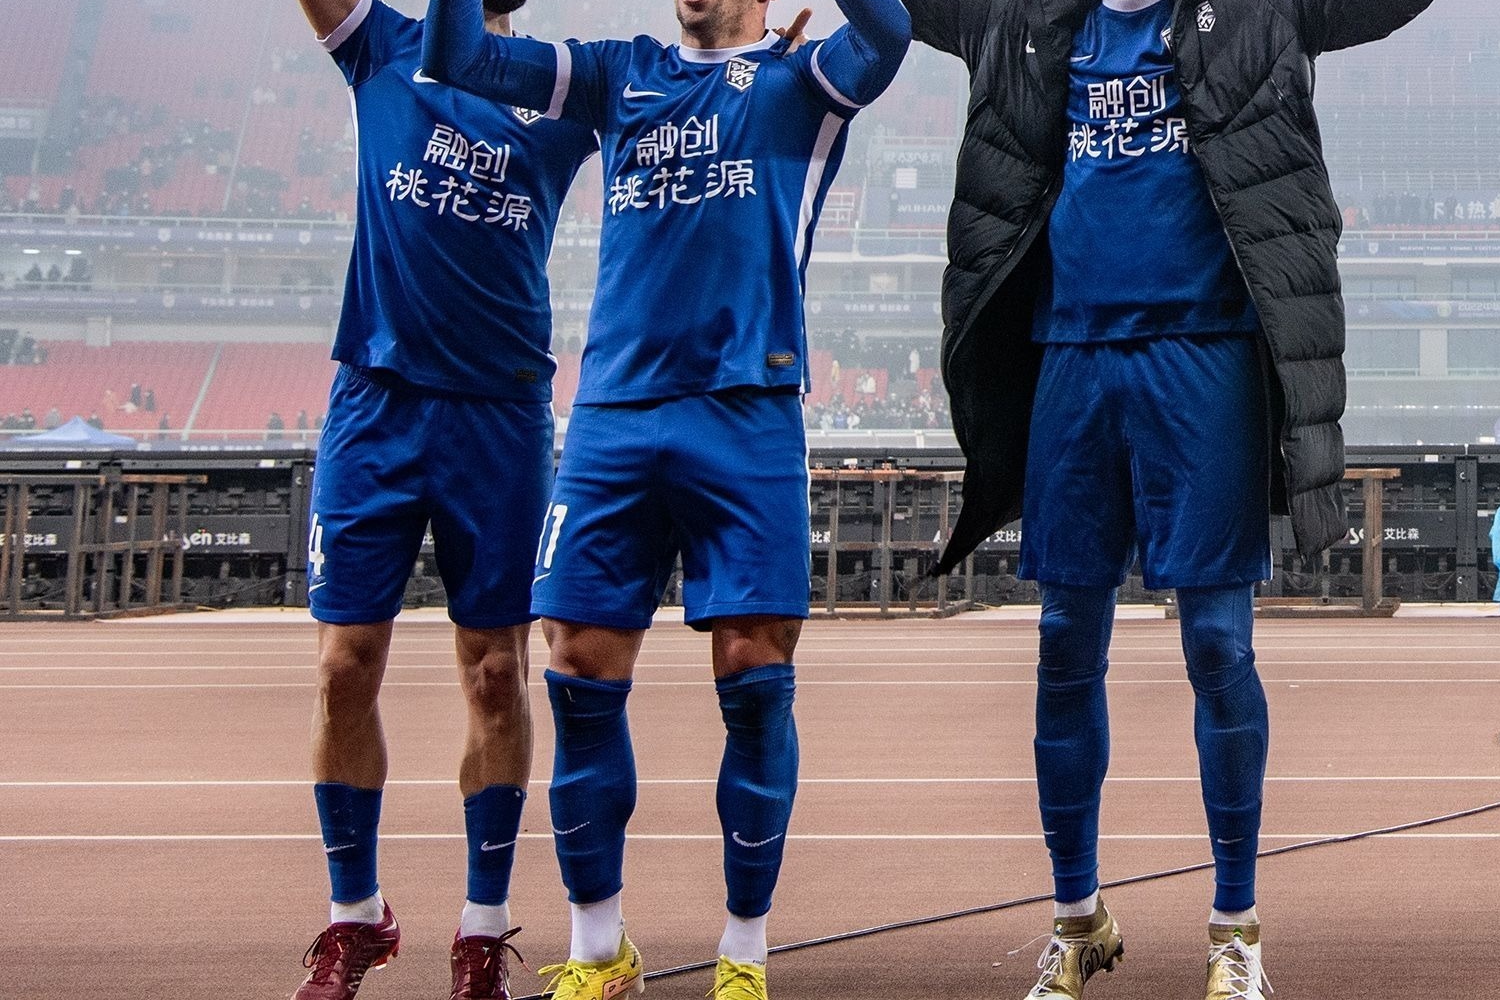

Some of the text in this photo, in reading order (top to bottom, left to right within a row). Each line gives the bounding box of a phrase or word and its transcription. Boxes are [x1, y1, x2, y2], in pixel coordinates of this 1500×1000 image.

[1087, 75, 1167, 120] 融创
[422, 123, 511, 184] 融创
[636, 113, 719, 167] 融创
[385, 162, 532, 232] 桃花源
[607, 159, 758, 216] 桃花源
[214, 532, 251, 546] 艾比森
[1384, 527, 1420, 541] 艾比森
